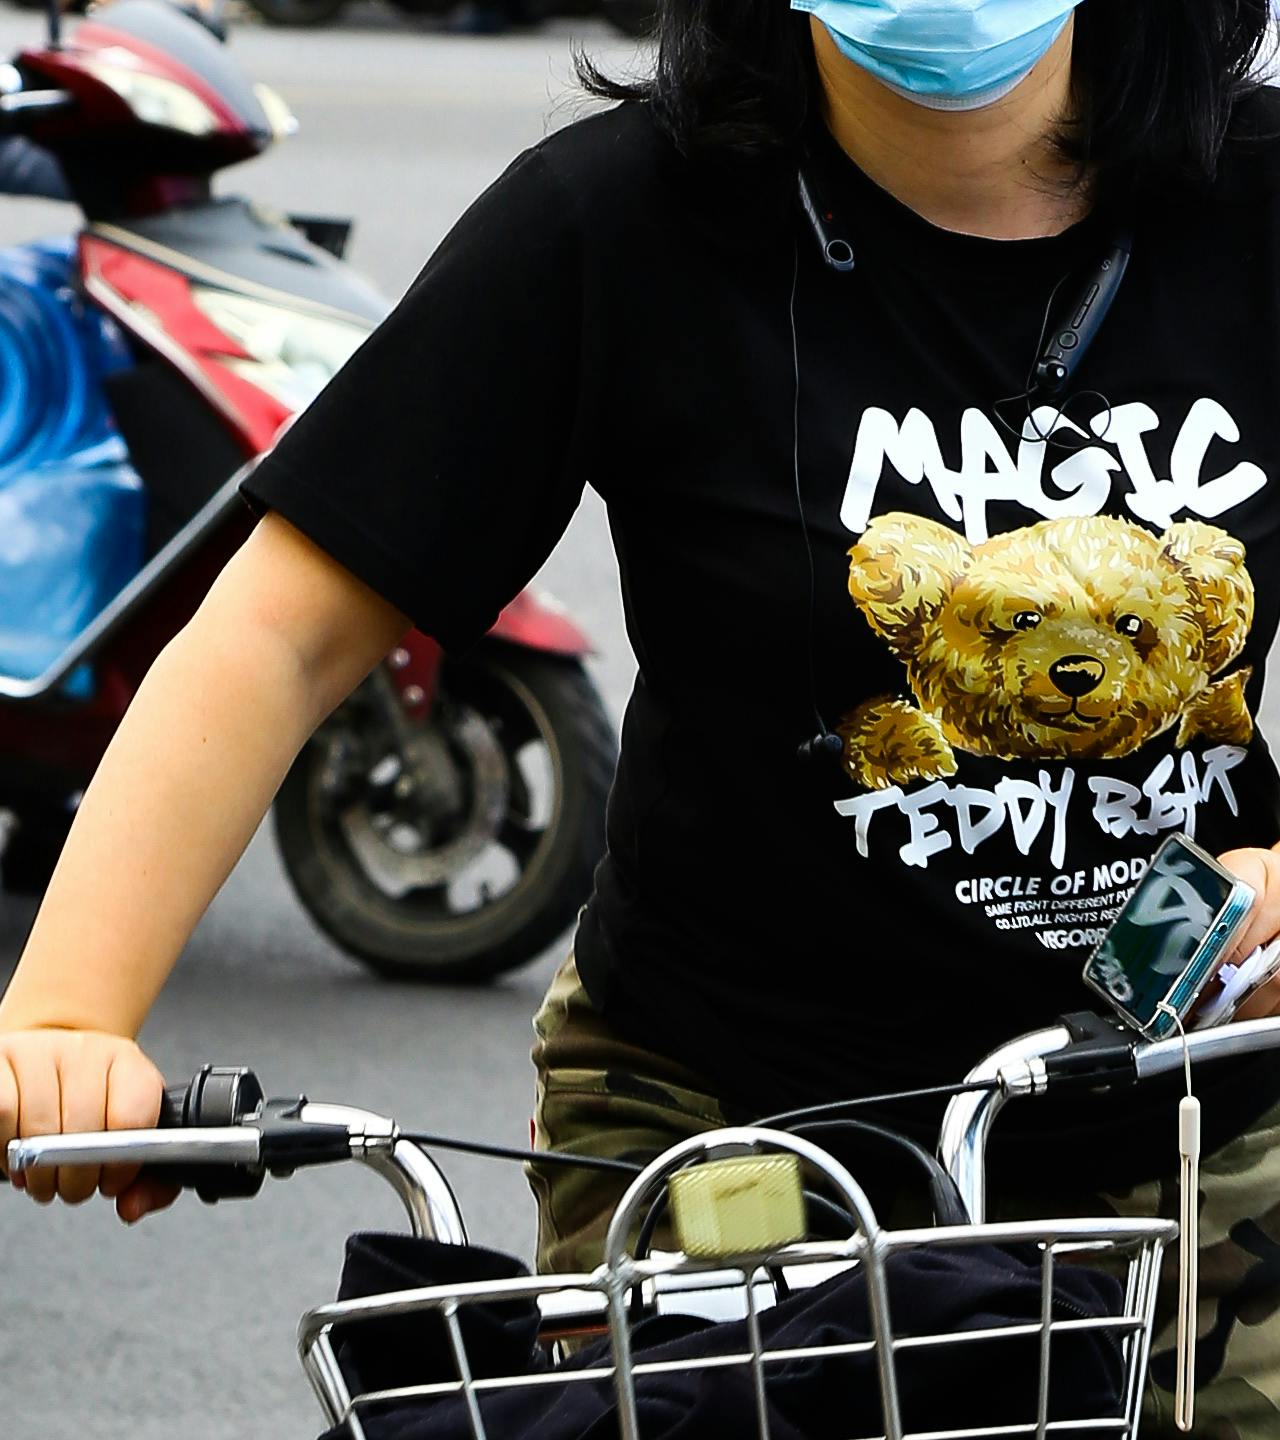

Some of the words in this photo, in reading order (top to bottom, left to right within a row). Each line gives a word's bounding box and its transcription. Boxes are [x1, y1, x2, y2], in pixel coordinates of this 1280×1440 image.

[840, 397, 1267, 544] MAGIC
[834, 767, 1075, 869] TEDDY
[1088, 745, 1248, 840] BEAR
[955, 876, 1041, 904] CIRCLE
[1051, 870, 1086, 895] OF
[1093, 855, 1153, 891] MOD
[1014, 900, 1050, 913] FIGHT
[1051, 893, 1115, 909] DIFFERENT
[1054, 911, 1098, 923] RIGHTS
